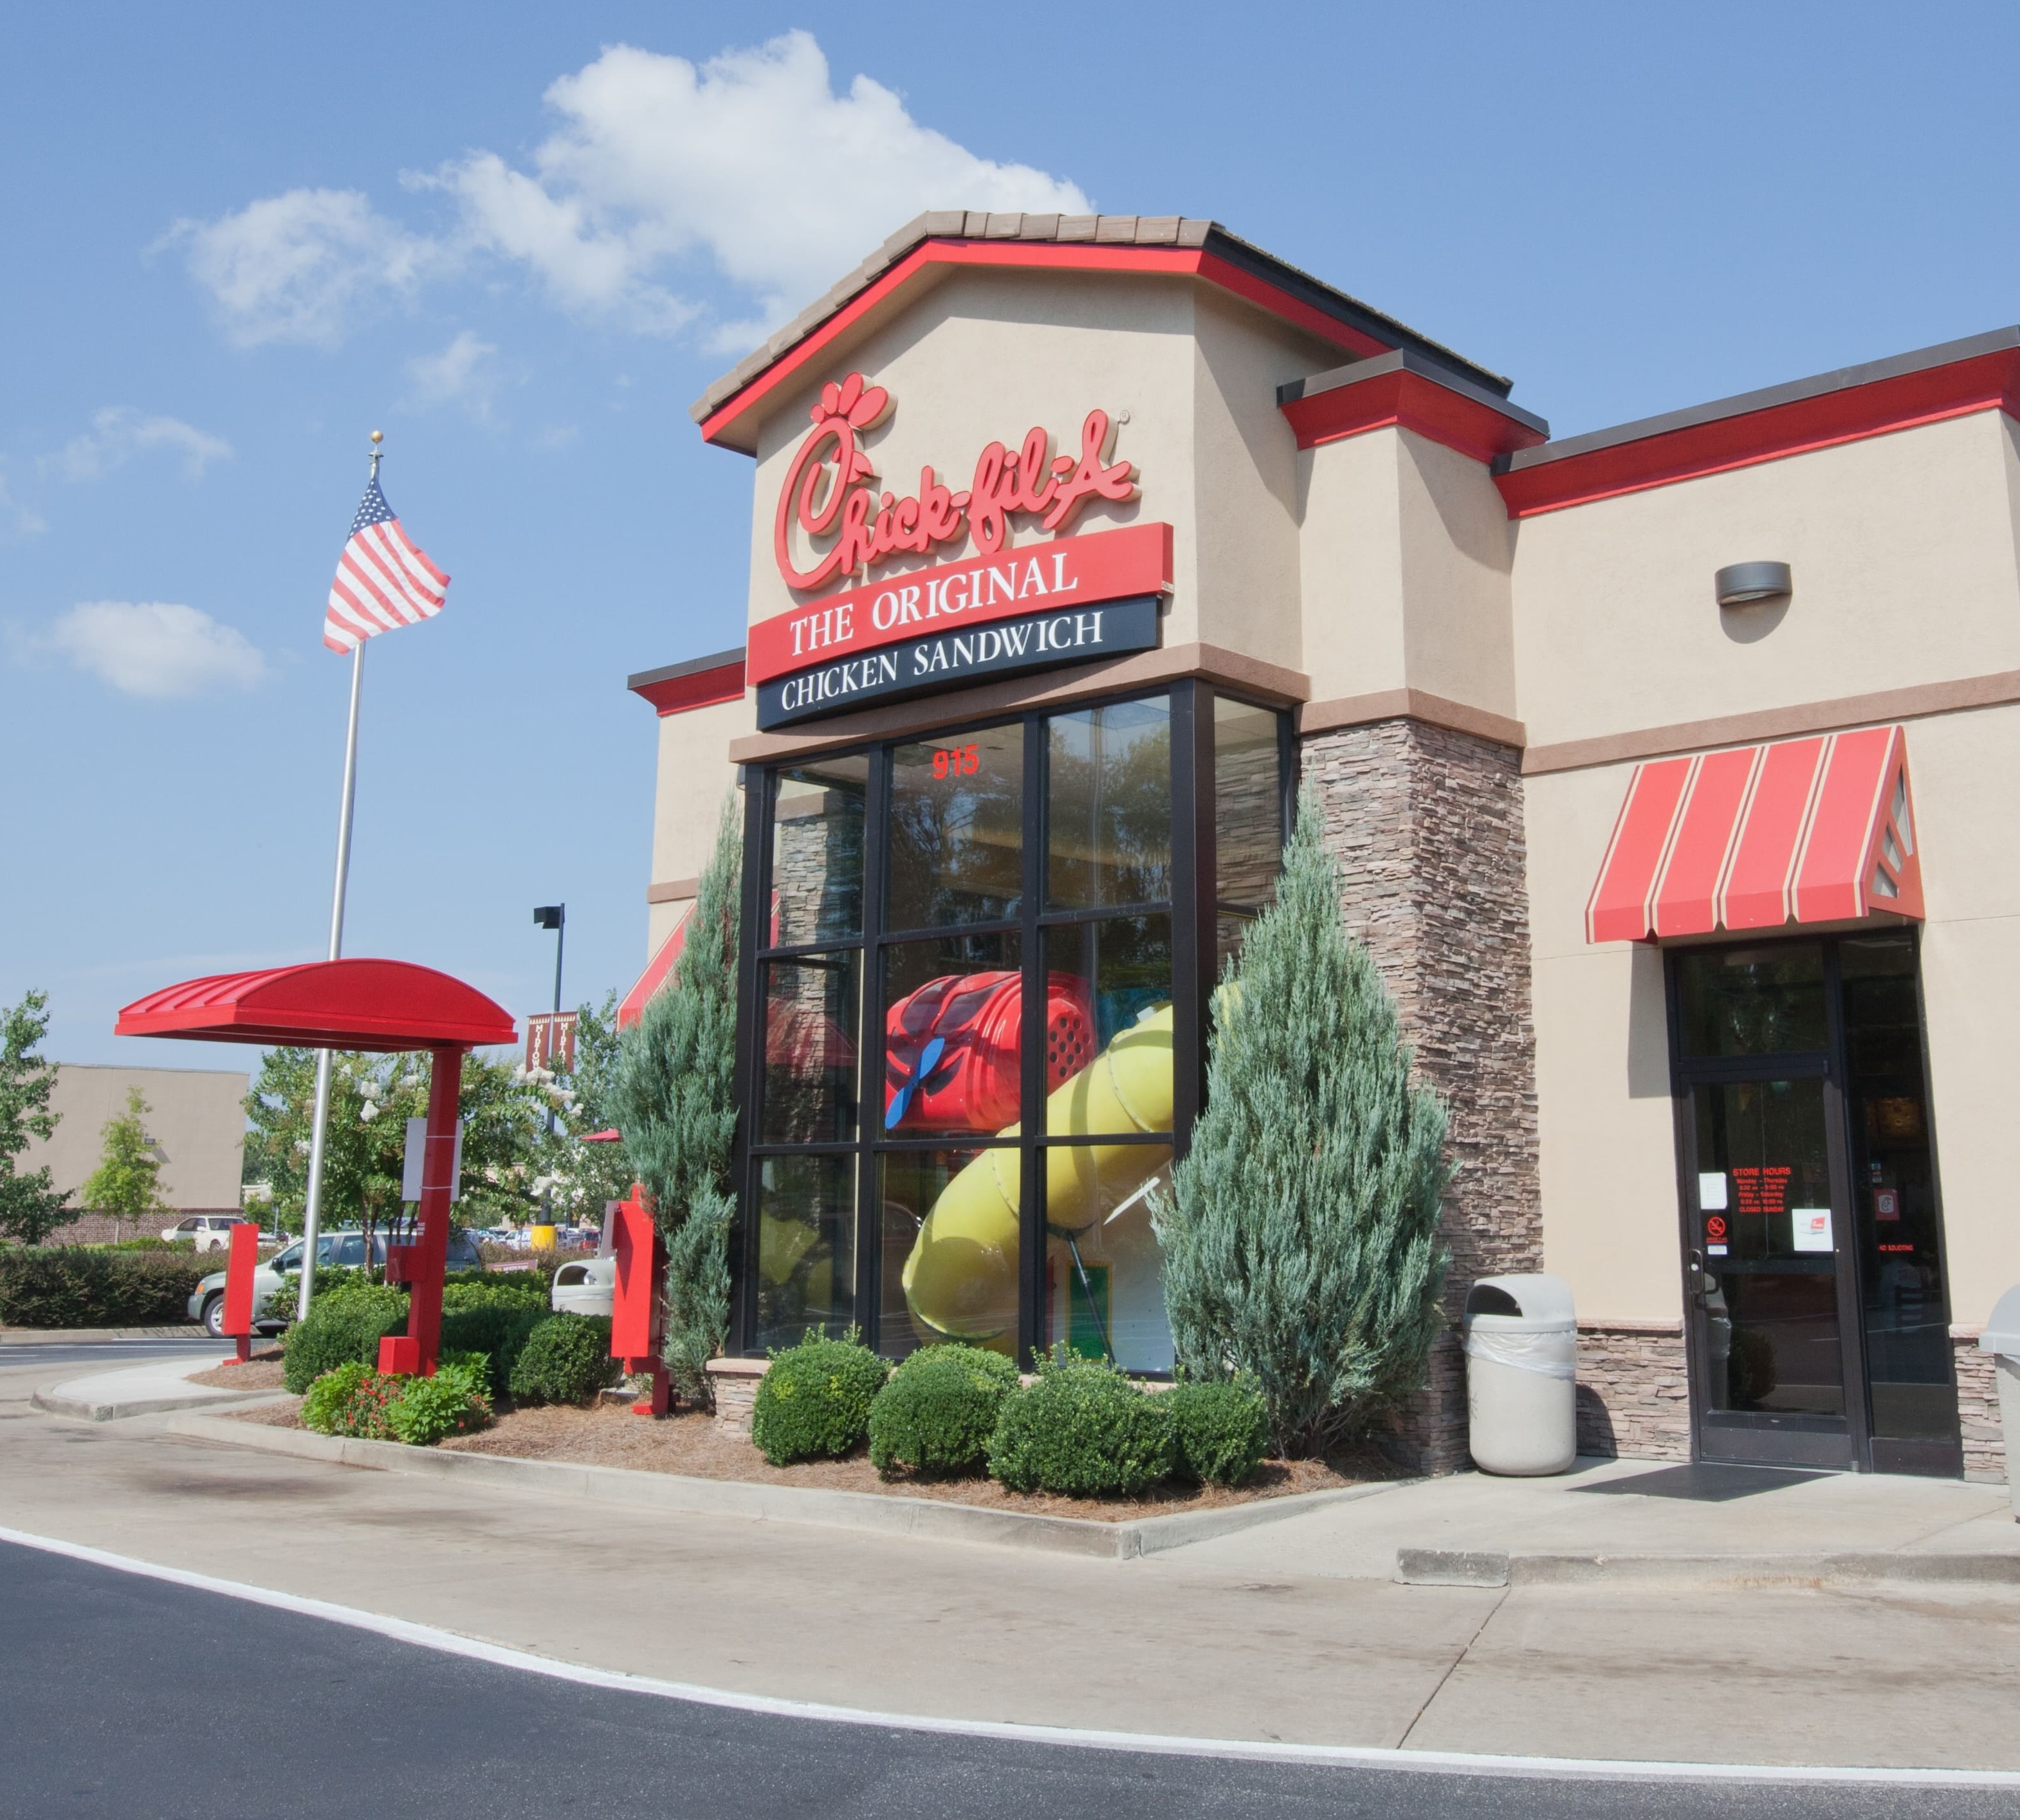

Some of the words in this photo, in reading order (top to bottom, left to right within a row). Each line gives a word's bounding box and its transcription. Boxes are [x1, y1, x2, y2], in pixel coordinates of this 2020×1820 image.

[774, 372, 1136, 589] Chick-fil-A
[789, 603, 854, 656] THE
[871, 552, 1078, 630] ORIGINAL
[781, 651, 898, 711] CHICKEN
[913, 611, 1103, 676] SANDWICH
[933, 744, 978, 780] 915
[532, 1024, 543, 1068] MIDTOW
[1732, 1168, 1759, 1177] STORE
[1763, 1166, 1792, 1175] HOURS
